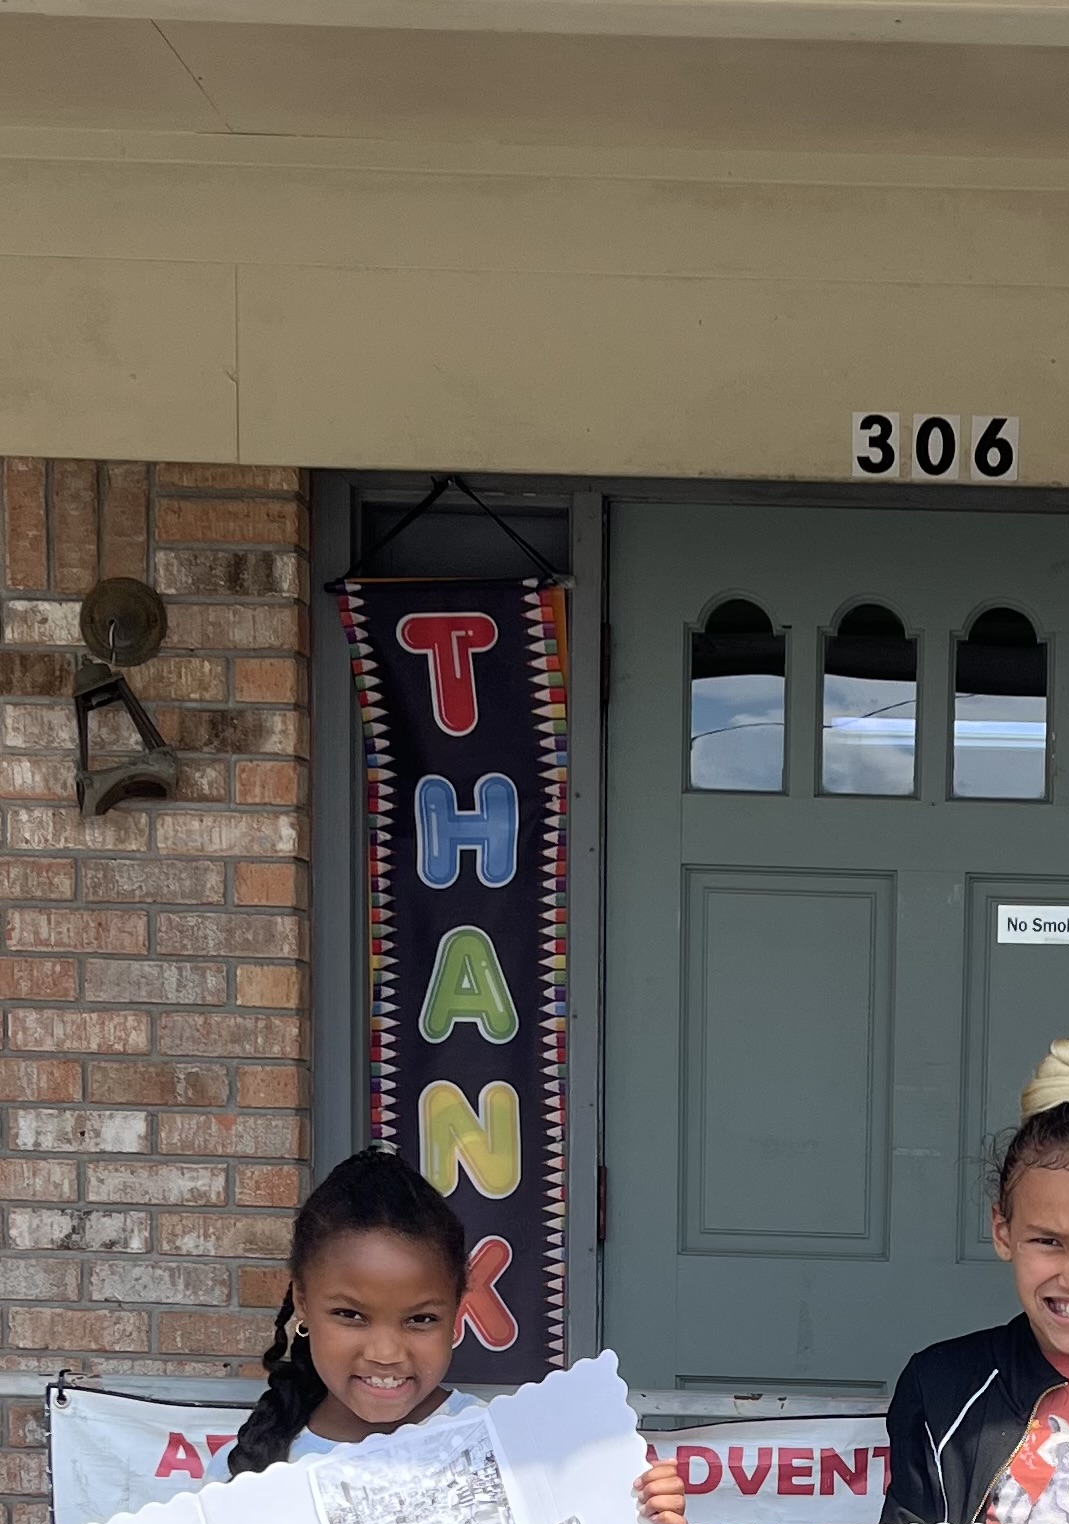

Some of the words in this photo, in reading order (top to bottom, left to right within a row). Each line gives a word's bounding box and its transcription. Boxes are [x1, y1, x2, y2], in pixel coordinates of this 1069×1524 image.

[855, 414, 1015, 478] 306
[1007, 917, 1028, 933] No
[396, 612, 522, 1352] THANK
[647, 1444, 892, 1496] DVENT
